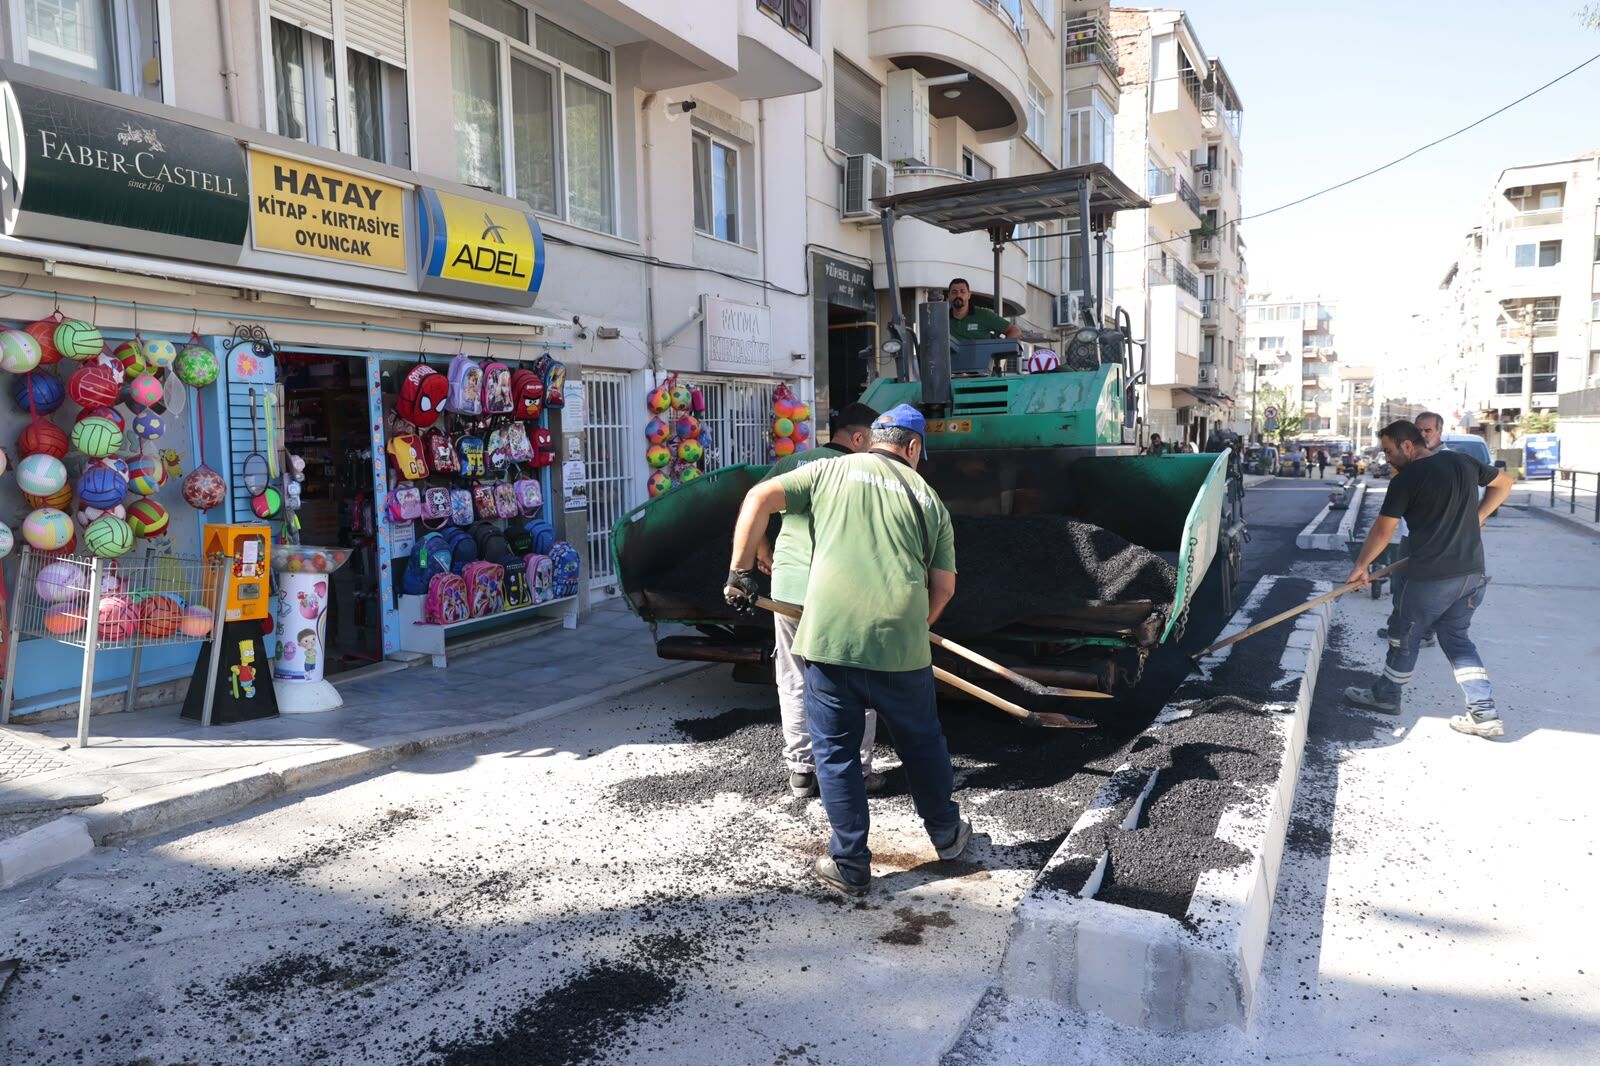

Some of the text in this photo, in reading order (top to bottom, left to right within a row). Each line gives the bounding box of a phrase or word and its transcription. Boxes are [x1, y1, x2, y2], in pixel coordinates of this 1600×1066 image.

[38, 129, 238, 197] FABER-CASTELL
[127, 178, 165, 193] since 1761
[273, 165, 383, 211] HATAY
[257, 194, 307, 220] KİTAP
[321, 209, 400, 239] KIRTASİYE
[295, 229, 372, 257] OYUNCAK
[451, 244, 526, 279] ADEL
[722, 307, 761, 335] FATMA
[255, 344, 265, 352] 24
